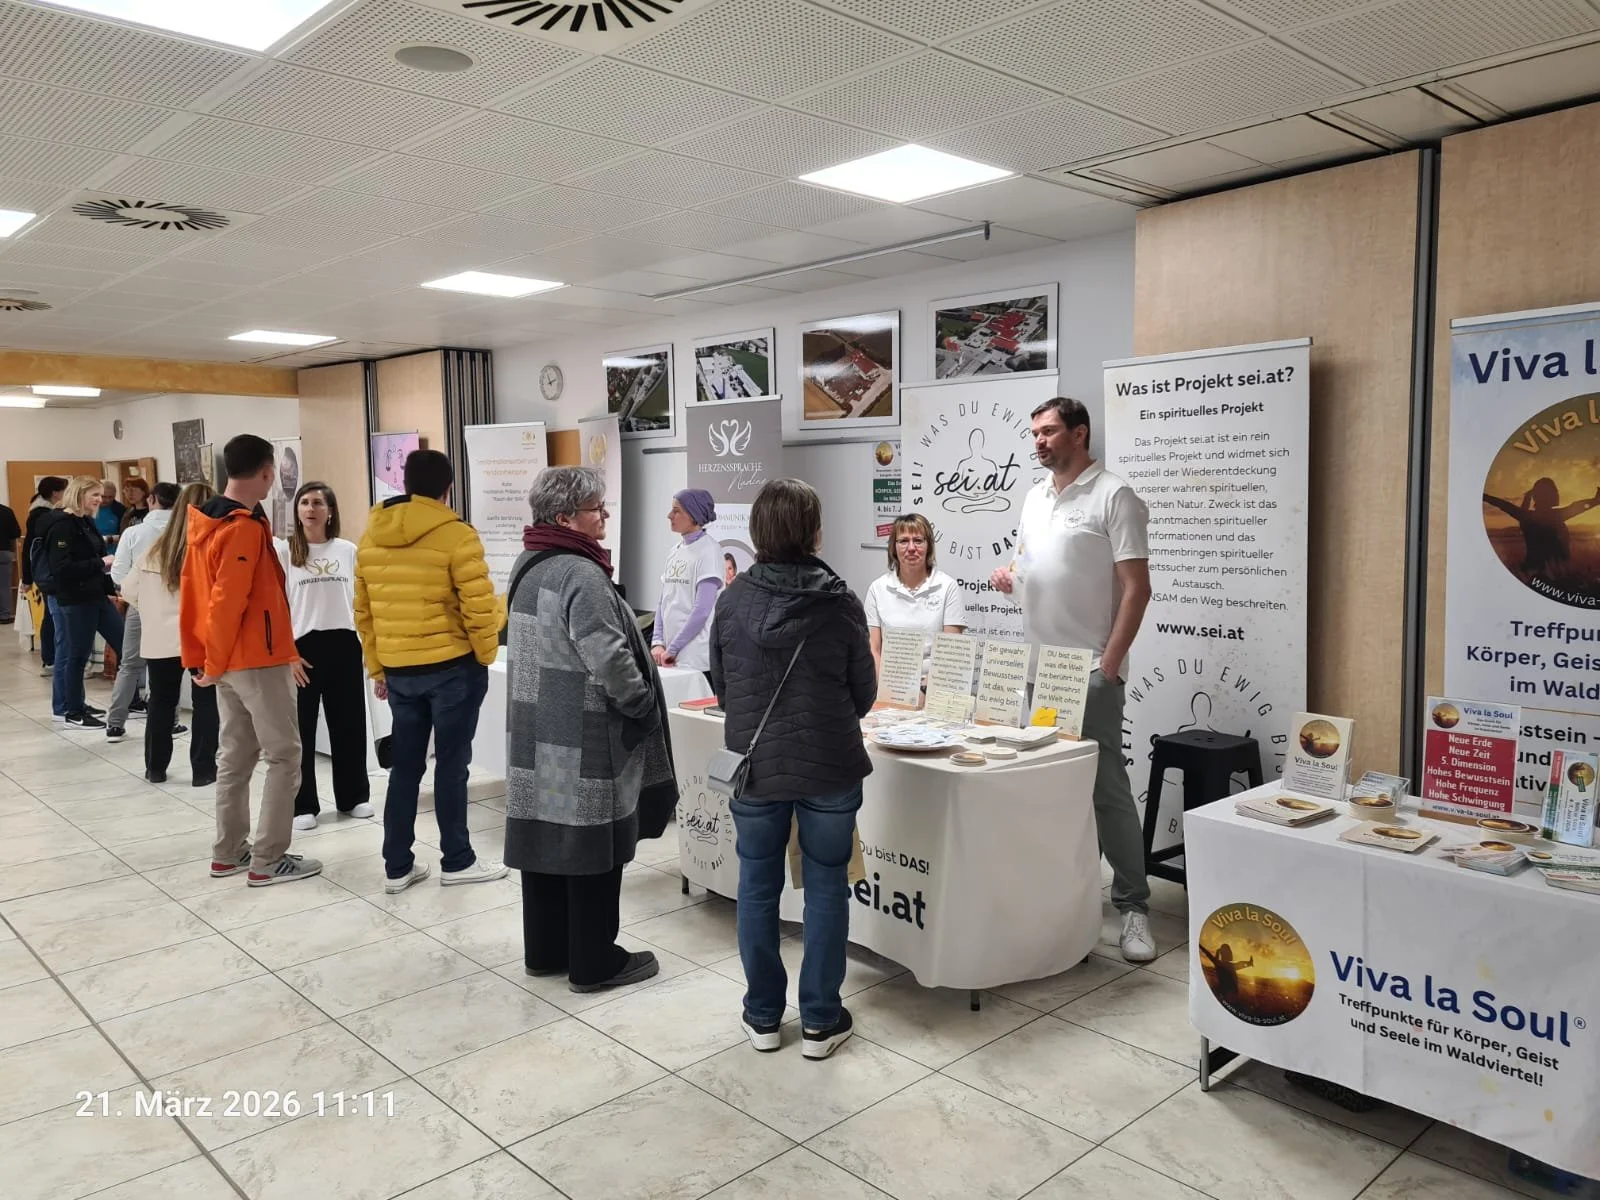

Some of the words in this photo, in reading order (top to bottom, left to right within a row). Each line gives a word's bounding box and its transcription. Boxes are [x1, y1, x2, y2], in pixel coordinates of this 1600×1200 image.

[1469, 348, 1569, 384] Viva
[1585, 339, 1600, 374] l
[1116, 382, 1148, 396] Was
[1152, 380, 1170, 393] ist
[1175, 374, 1233, 393] Projekt
[1238, 366, 1294, 386] sei.at?
[1140, 410, 1155, 419] Ein
[1159, 405, 1218, 421] spirituelles
[1221, 402, 1264, 417] Projekt
[1513, 411, 1583, 453] Viva
[1588, 400, 1600, 423] l
[1135, 438, 1151, 446] Das
[1154, 436, 1187, 447] Projekt
[1190, 435, 1214, 444] sei.at
[1218, 434, 1229, 442] ist
[1233, 433, 1247, 441] ein
[1251, 432, 1269, 441] rein
[912, 462, 923, 505] SEI!
[920, 414, 948, 448] WAS
[959, 401, 978, 416] DU
[992, 403, 1030, 439] EWIG
[1030, 452, 1045, 485] BIS
[1119, 454, 1166, 464] spirituelles
[1169, 451, 1201, 462] Projekt
[1205, 450, 1224, 459] und
[1228, 449, 1265, 459] widmet
[1269, 448, 1289, 457] sich
[699, 462, 762, 472] HERZENSSPRACHE
[934, 453, 1020, 495] sei.at
[1128, 470, 1160, 479] speziell
[1164, 469, 1178, 477] der
[1182, 466, 1276, 477] Wiederentdeckung
[1173, 484, 1206, 493] wahren
[1209, 483, 1267, 494] spirituellen,
[1209, 500, 1240, 508] Zweck
[1244, 500, 1256, 508] ist
[1259, 500, 1277, 508] das
[1214, 517, 1268, 526] spiritueller
[1149, 532, 1212, 540] nformationen
[1216, 533, 1235, 541] und
[950, 541, 982, 560] BIST
[1149, 548, 1217, 557] ammenbringen
[1220, 550, 1273, 559] spiritueller
[1149, 564, 1195, 572] eitssucher
[1222, 566, 1287, 576] persönlichen
[957, 579, 1000, 594] Projek
[1172, 579, 1224, 589] Austausch.
[965, 604, 988, 612] uelles
[991, 605, 1022, 616] Projekt
[1151, 593, 1177, 603] NSAM
[1181, 595, 1197, 604] den
[1201, 596, 1223, 608] Weg
[1226, 599, 1288, 611] beschreiten.
[1157, 623, 1244, 640] www.sei.at
[988, 644, 998, 652] Sei
[987, 658, 1024, 668] universelles
[1467, 646, 1546, 670] Körper,
[984, 669, 1024, 680] Bewusstsein
[1069, 663, 1083, 671] Welt
[1130, 667, 1164, 702] WAS
[1178, 659, 1202, 674] DU
[1220, 667, 1272, 716] EWIG
[1510, 676, 1536, 693] im
[1048, 694, 1062, 703] Welt
[1464, 707, 1481, 715] Viva
[1484, 709, 1492, 717] la
[1494, 711, 1513, 719] Soul
[1449, 735, 1470, 744] Neue
[1473, 737, 1492, 747] Erde
[1519, 725, 1586, 744] stsein
[1449, 747, 1470, 757] Neue
[1473, 749, 1490, 759] Zeit
[1295, 756, 1310, 765] Viva
[1322, 762, 1337, 771] Soul
[1441, 757, 1448, 765] 5.
[1451, 758, 1496, 772] Dimension
[1427, 766, 1452, 777] Hohes
[1455, 770, 1510, 786] Bewusstsein
[1436, 779, 1457, 789] Hohe
[1460, 783, 1498, 796] Frequenz
[1429, 789, 1449, 800] Hohe
[1452, 793, 1505, 811] Schwingung
[687, 812, 719, 833] sei.at
[876, 846, 896, 863] bist
[900, 854, 929, 875] DAS!
[1212, 910, 1243, 928] Viva
[1246, 907, 1260, 921] la
[1262, 914, 1296, 945] Soul
[1330, 951, 1412, 1001] Viva
[1425, 975, 1460, 1014] la
[1338, 993, 1423, 1028] Treffpunkte
[1427, 1019, 1449, 1036] für
[1454, 1027, 1512, 1057] Körper,
[1516, 1047, 1559, 1070] Geist
[1350, 1018, 1376, 1034] und
[1379, 1028, 1421, 1047] Seele
[1424, 1038, 1442, 1054] im
[1446, 1045, 1543, 1086] Waldviertel!
